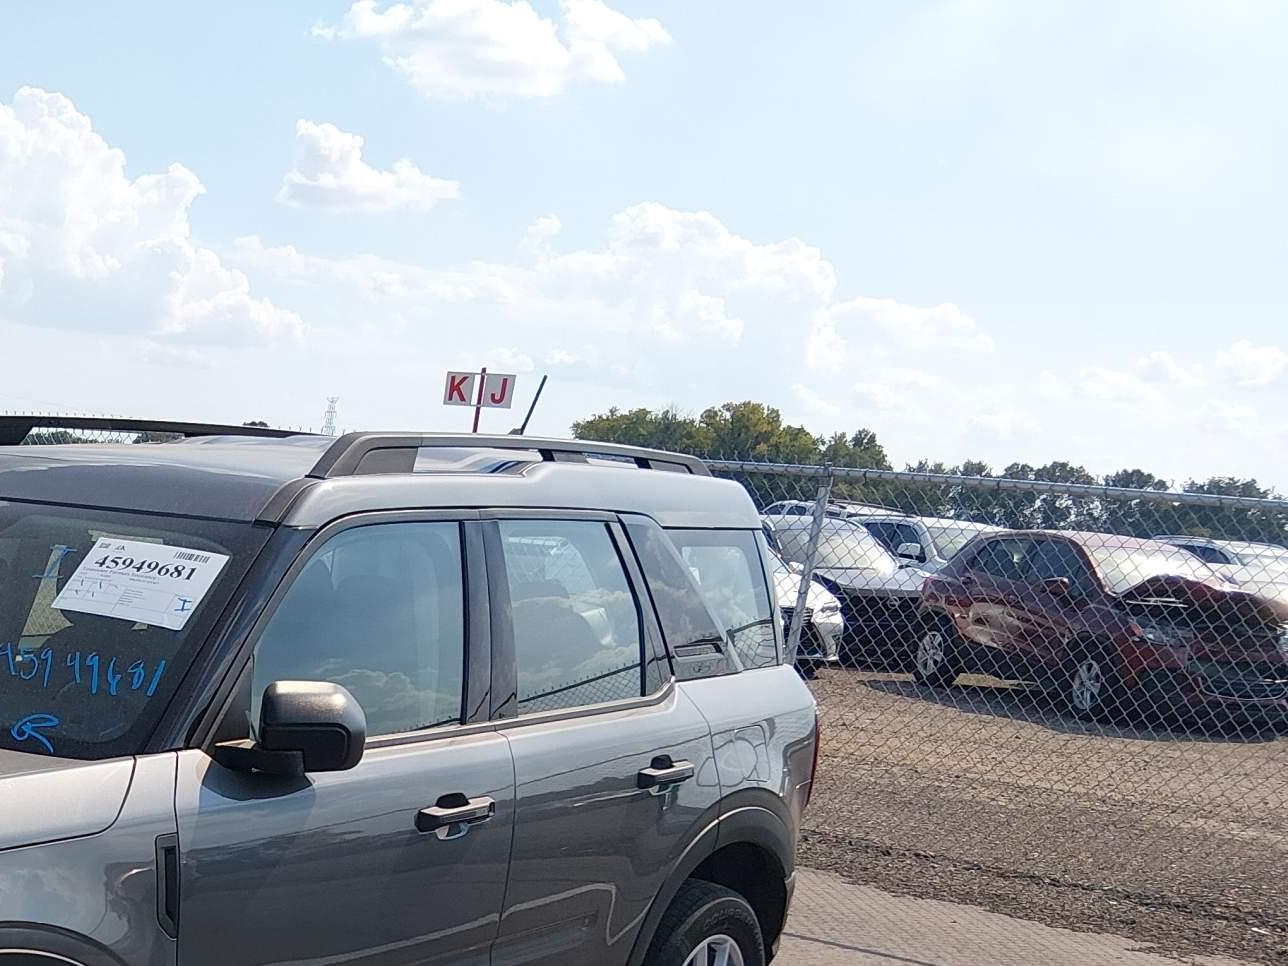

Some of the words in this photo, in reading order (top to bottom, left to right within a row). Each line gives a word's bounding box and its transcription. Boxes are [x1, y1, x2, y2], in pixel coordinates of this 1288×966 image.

[447, 375, 470, 402] K
[490, 377, 509, 405] J
[94, 554, 198, 581] 45949681
